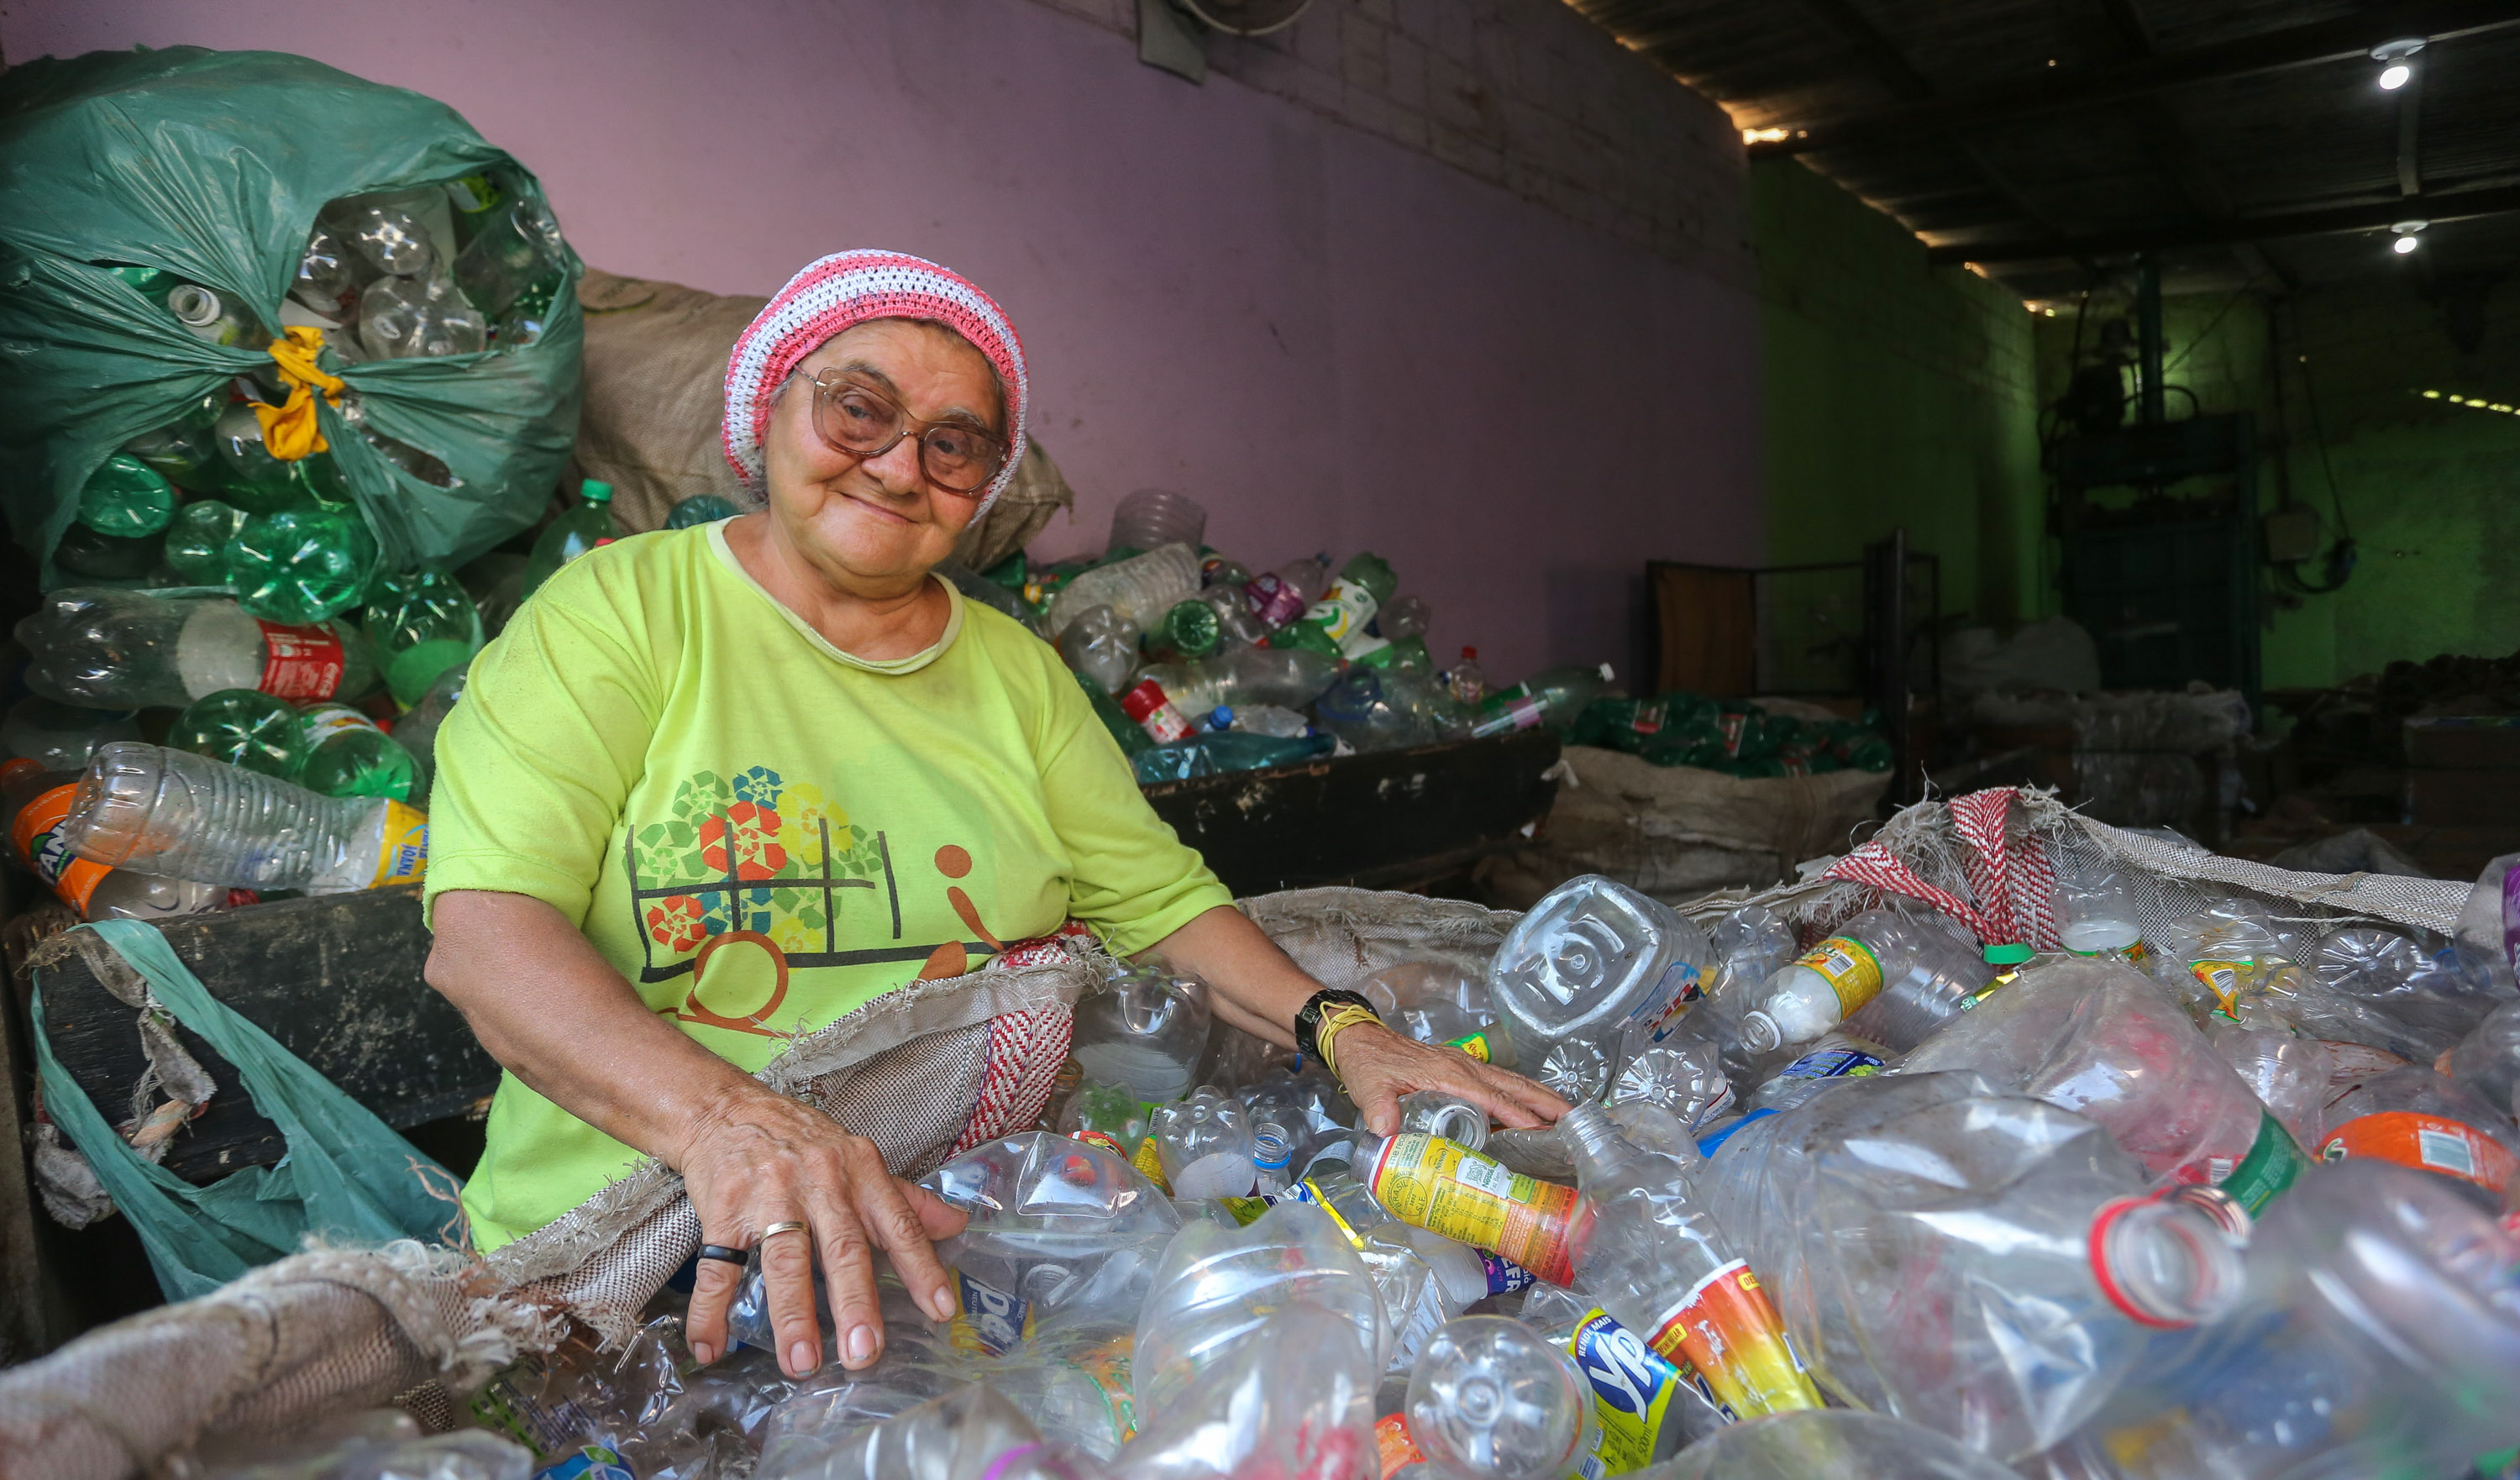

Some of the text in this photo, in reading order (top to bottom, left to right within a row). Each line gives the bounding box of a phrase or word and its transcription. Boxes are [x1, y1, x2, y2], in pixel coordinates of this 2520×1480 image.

[396, 842, 418, 875] JOANA
[1436, 1150, 1447, 1171] NINHO
[1394, 1179, 1409, 1210] BRASIL
[1482, 1168, 1495, 1188] Nestlé
[1501, 1257, 1521, 1294] EFR
[1578, 1315, 1612, 1358] RENDE MAIS
[1637, 1425, 1653, 1458] 500ml
